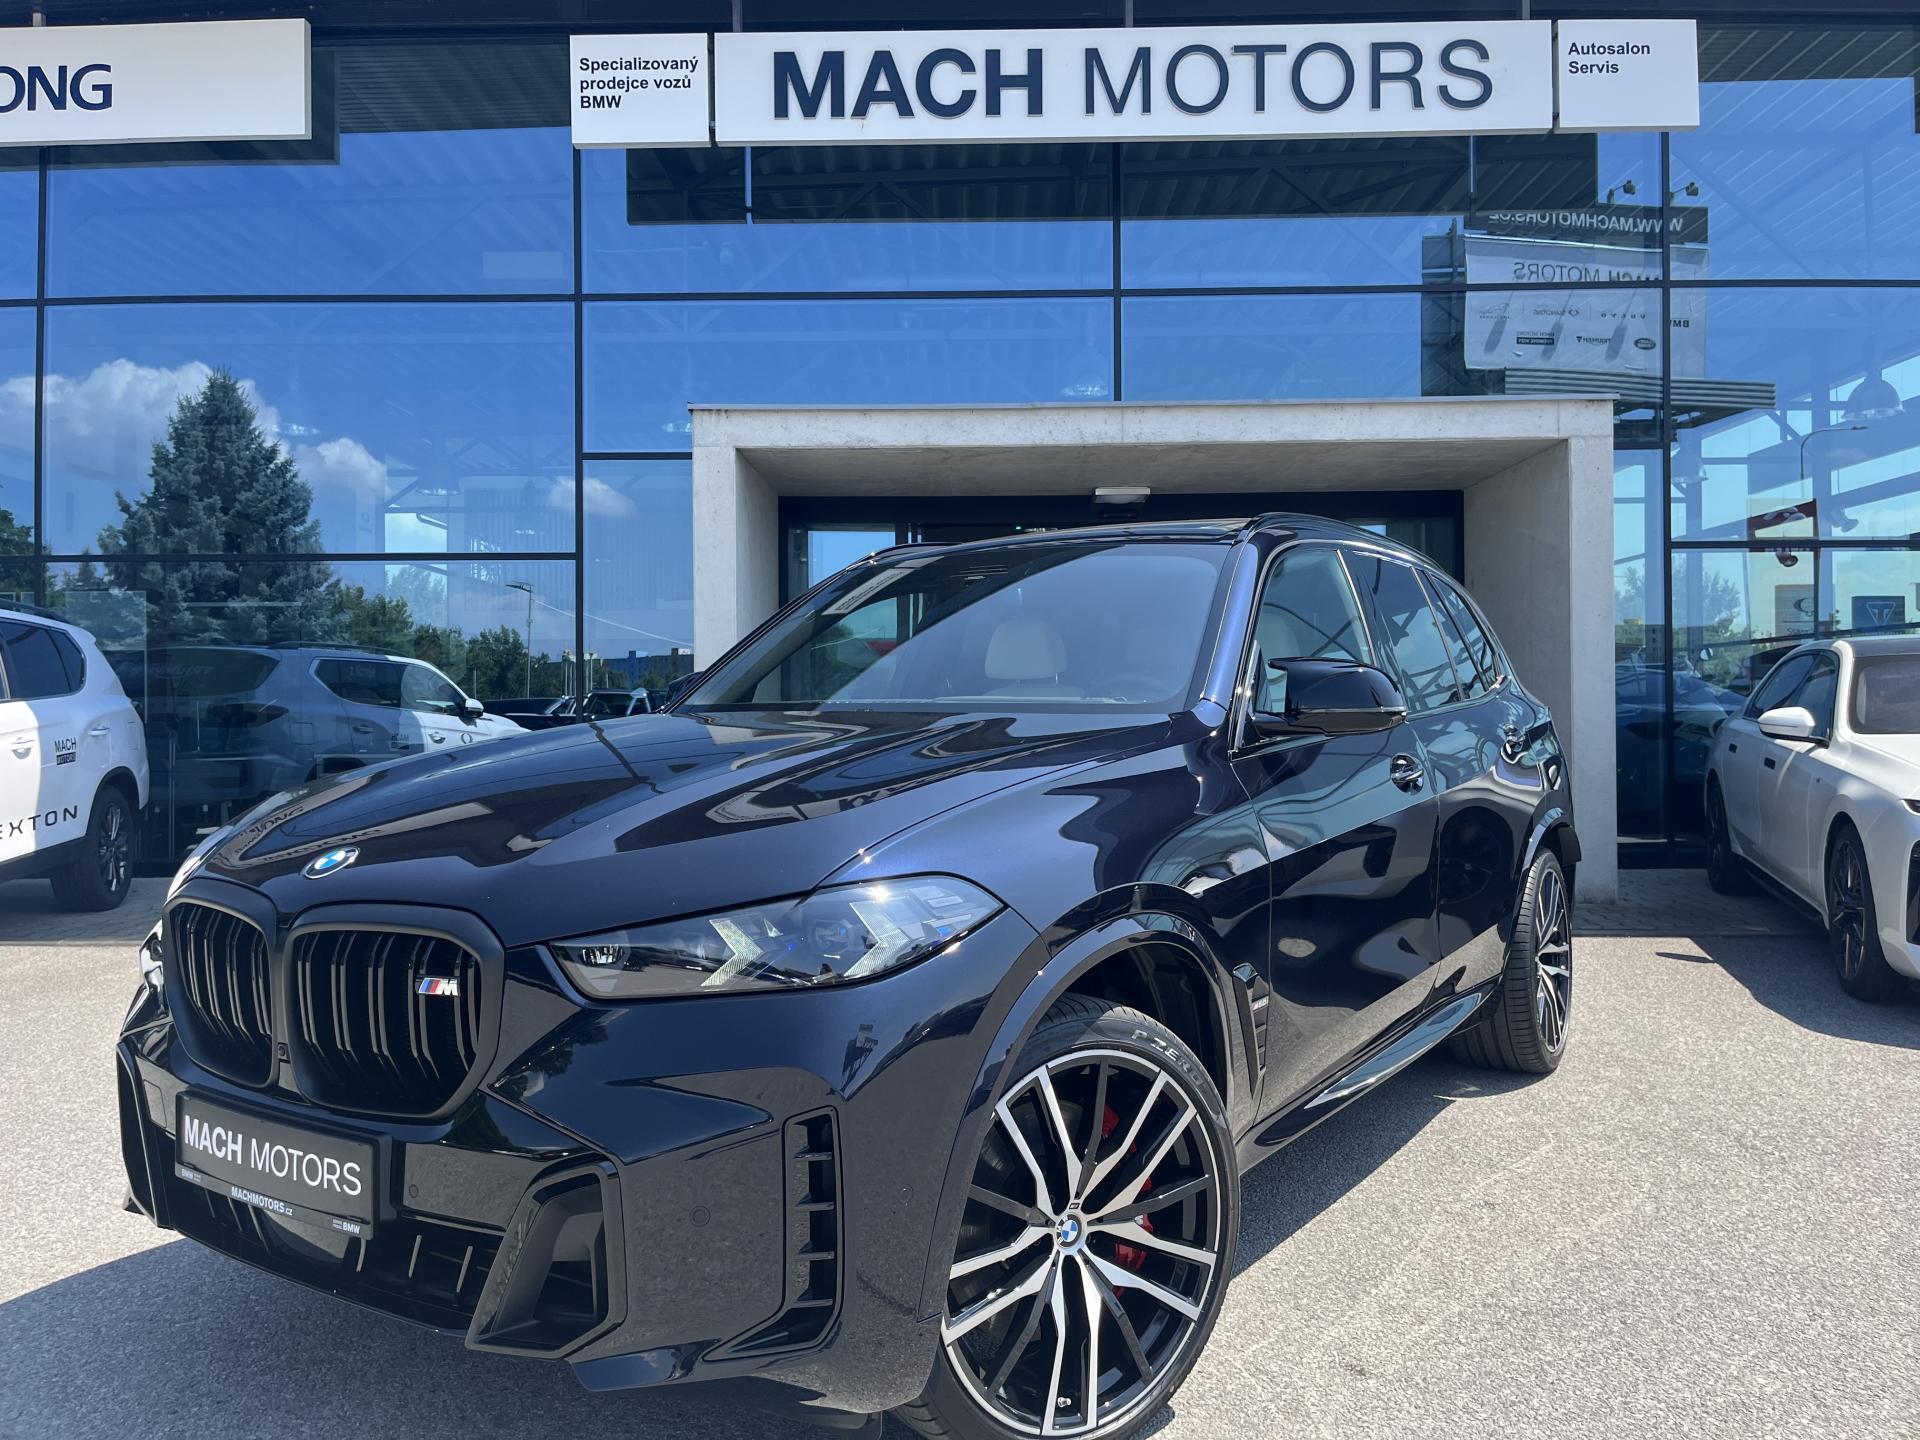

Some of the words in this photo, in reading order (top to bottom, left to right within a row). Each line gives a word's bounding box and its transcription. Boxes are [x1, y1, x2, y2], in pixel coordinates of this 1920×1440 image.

[1568, 42, 1651, 55] Autosalon
[579, 56, 699, 74] Specializovaný
[1568, 61, 1620, 74] Servis
[580, 76, 649, 93] prodejce
[654, 75, 691, 89] vozů
[773, 48, 1043, 119] MACH
[1084, 38, 1494, 116] MOTORS
[580, 95, 622, 109] BMW
[54, 737, 77, 753] MACH
[0, 805, 78, 840] XTON
[184, 1115, 242, 1165] MACH
[250, 1138, 362, 1196] MOTORS
[342, 1221, 361, 1235] BMW
